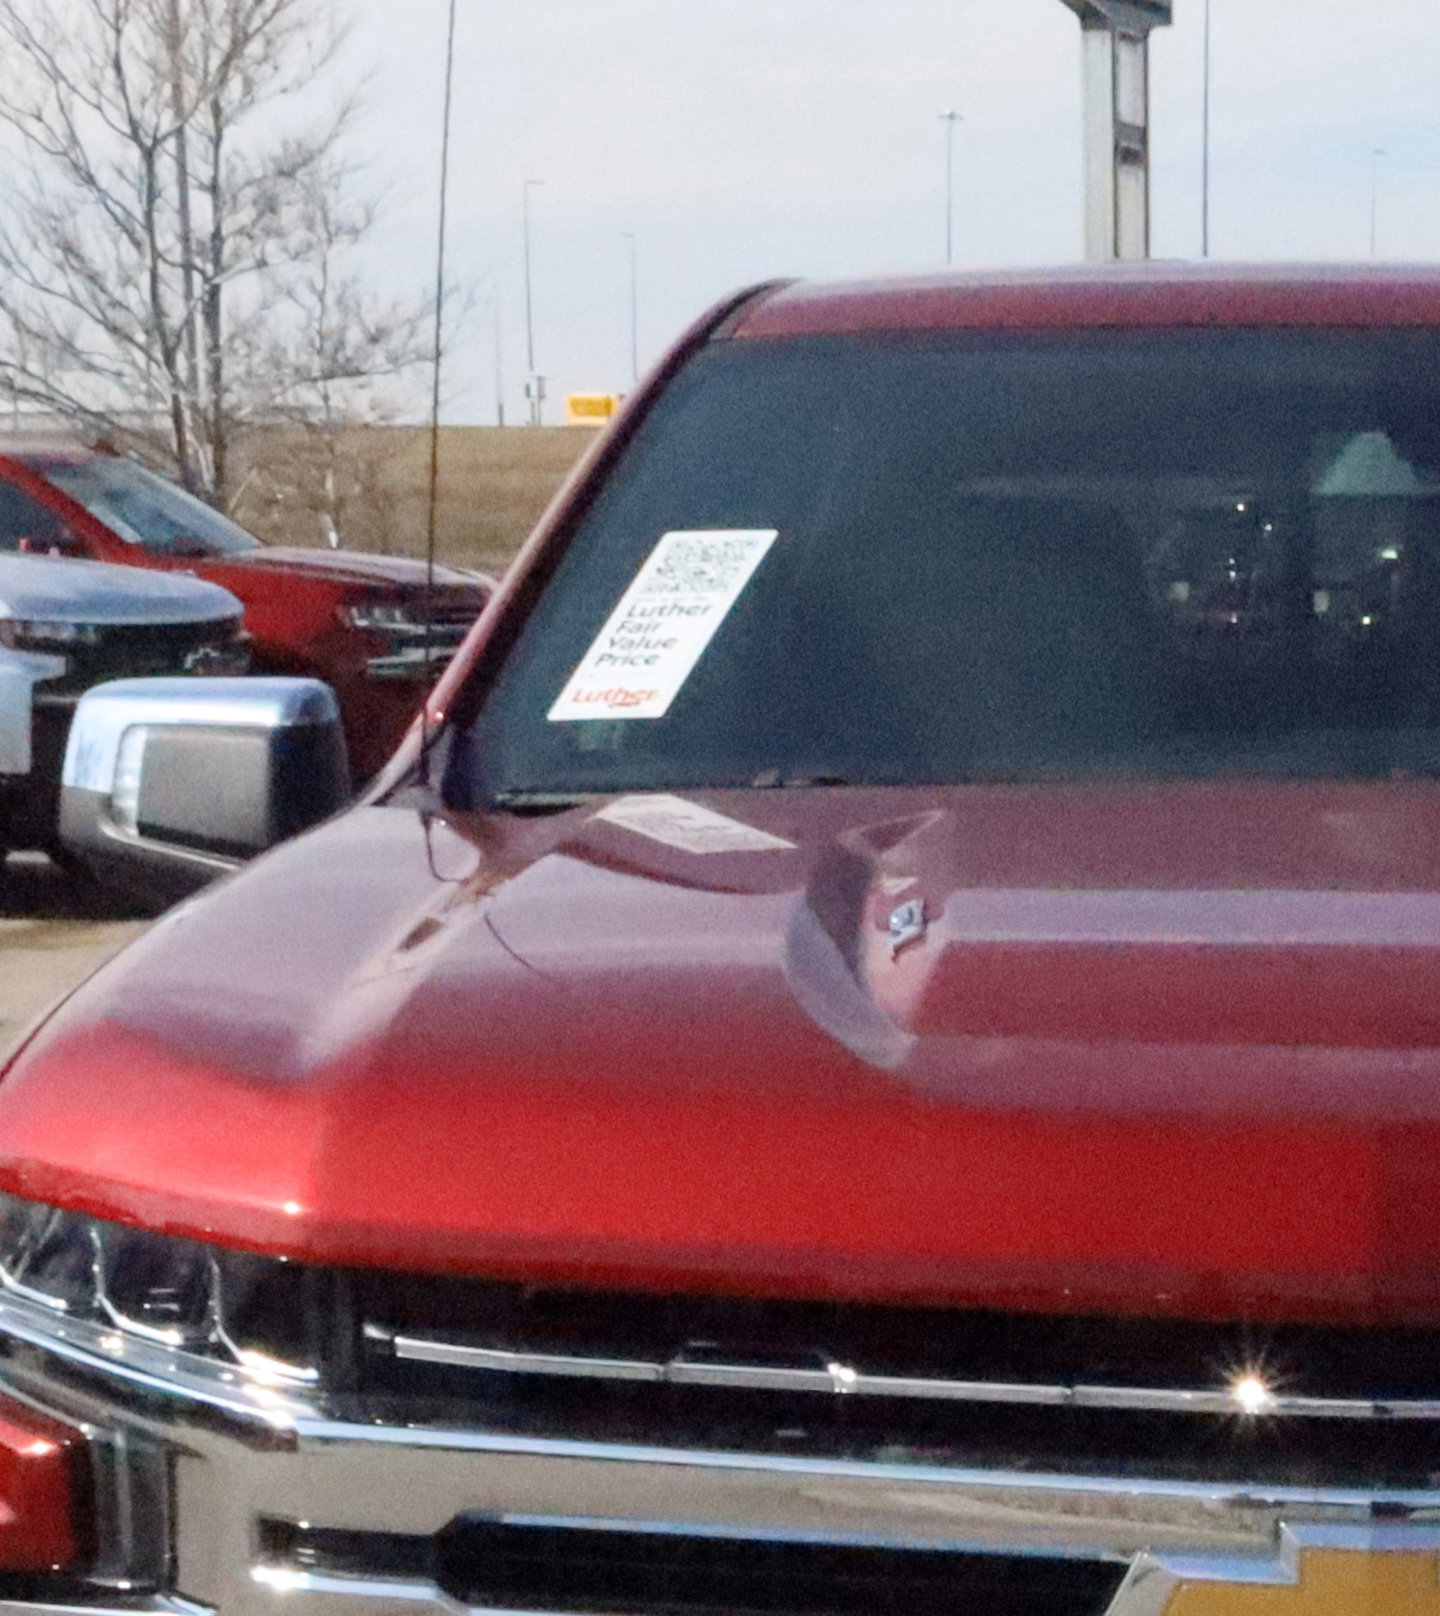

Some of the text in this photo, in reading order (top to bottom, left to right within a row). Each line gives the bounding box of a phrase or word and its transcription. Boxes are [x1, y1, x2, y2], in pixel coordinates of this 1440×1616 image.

[626, 603, 713, 618] Luther
[616, 620, 663, 634] Fair
[610, 636, 679, 650] Value
[595, 652, 661, 667] Price
[572, 687, 658, 703] Luther
